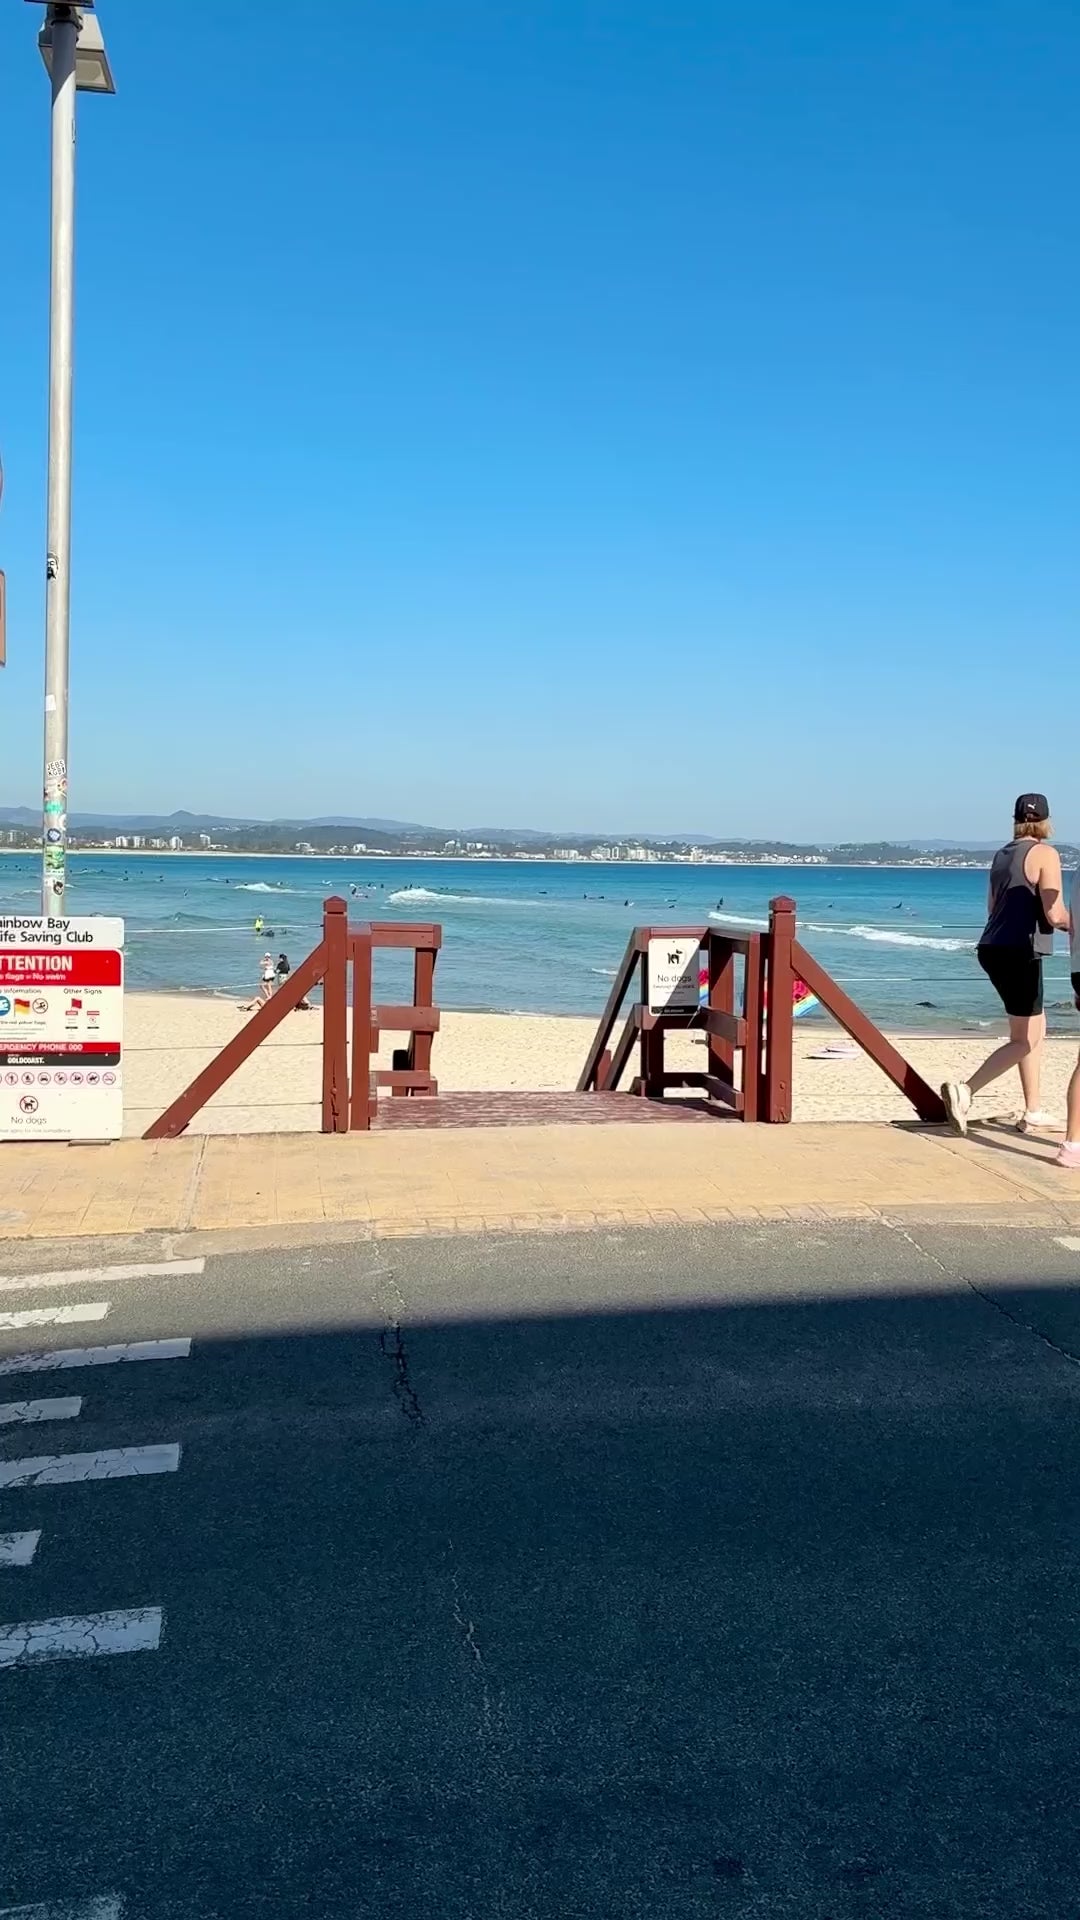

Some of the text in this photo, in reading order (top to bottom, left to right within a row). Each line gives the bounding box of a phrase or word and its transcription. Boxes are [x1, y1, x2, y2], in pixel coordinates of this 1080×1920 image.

[47, 917, 70, 931] Bay
[20, 931, 61, 945] Saving
[66, 931, 93, 942] Club
[657, 974, 692, 984] No dogs
[84, 988, 102, 996] Signs
[38, 1043, 67, 1051] PHONE
[68, 1043, 83, 1051] 000
[11, 1116, 47, 1125] No dogs
